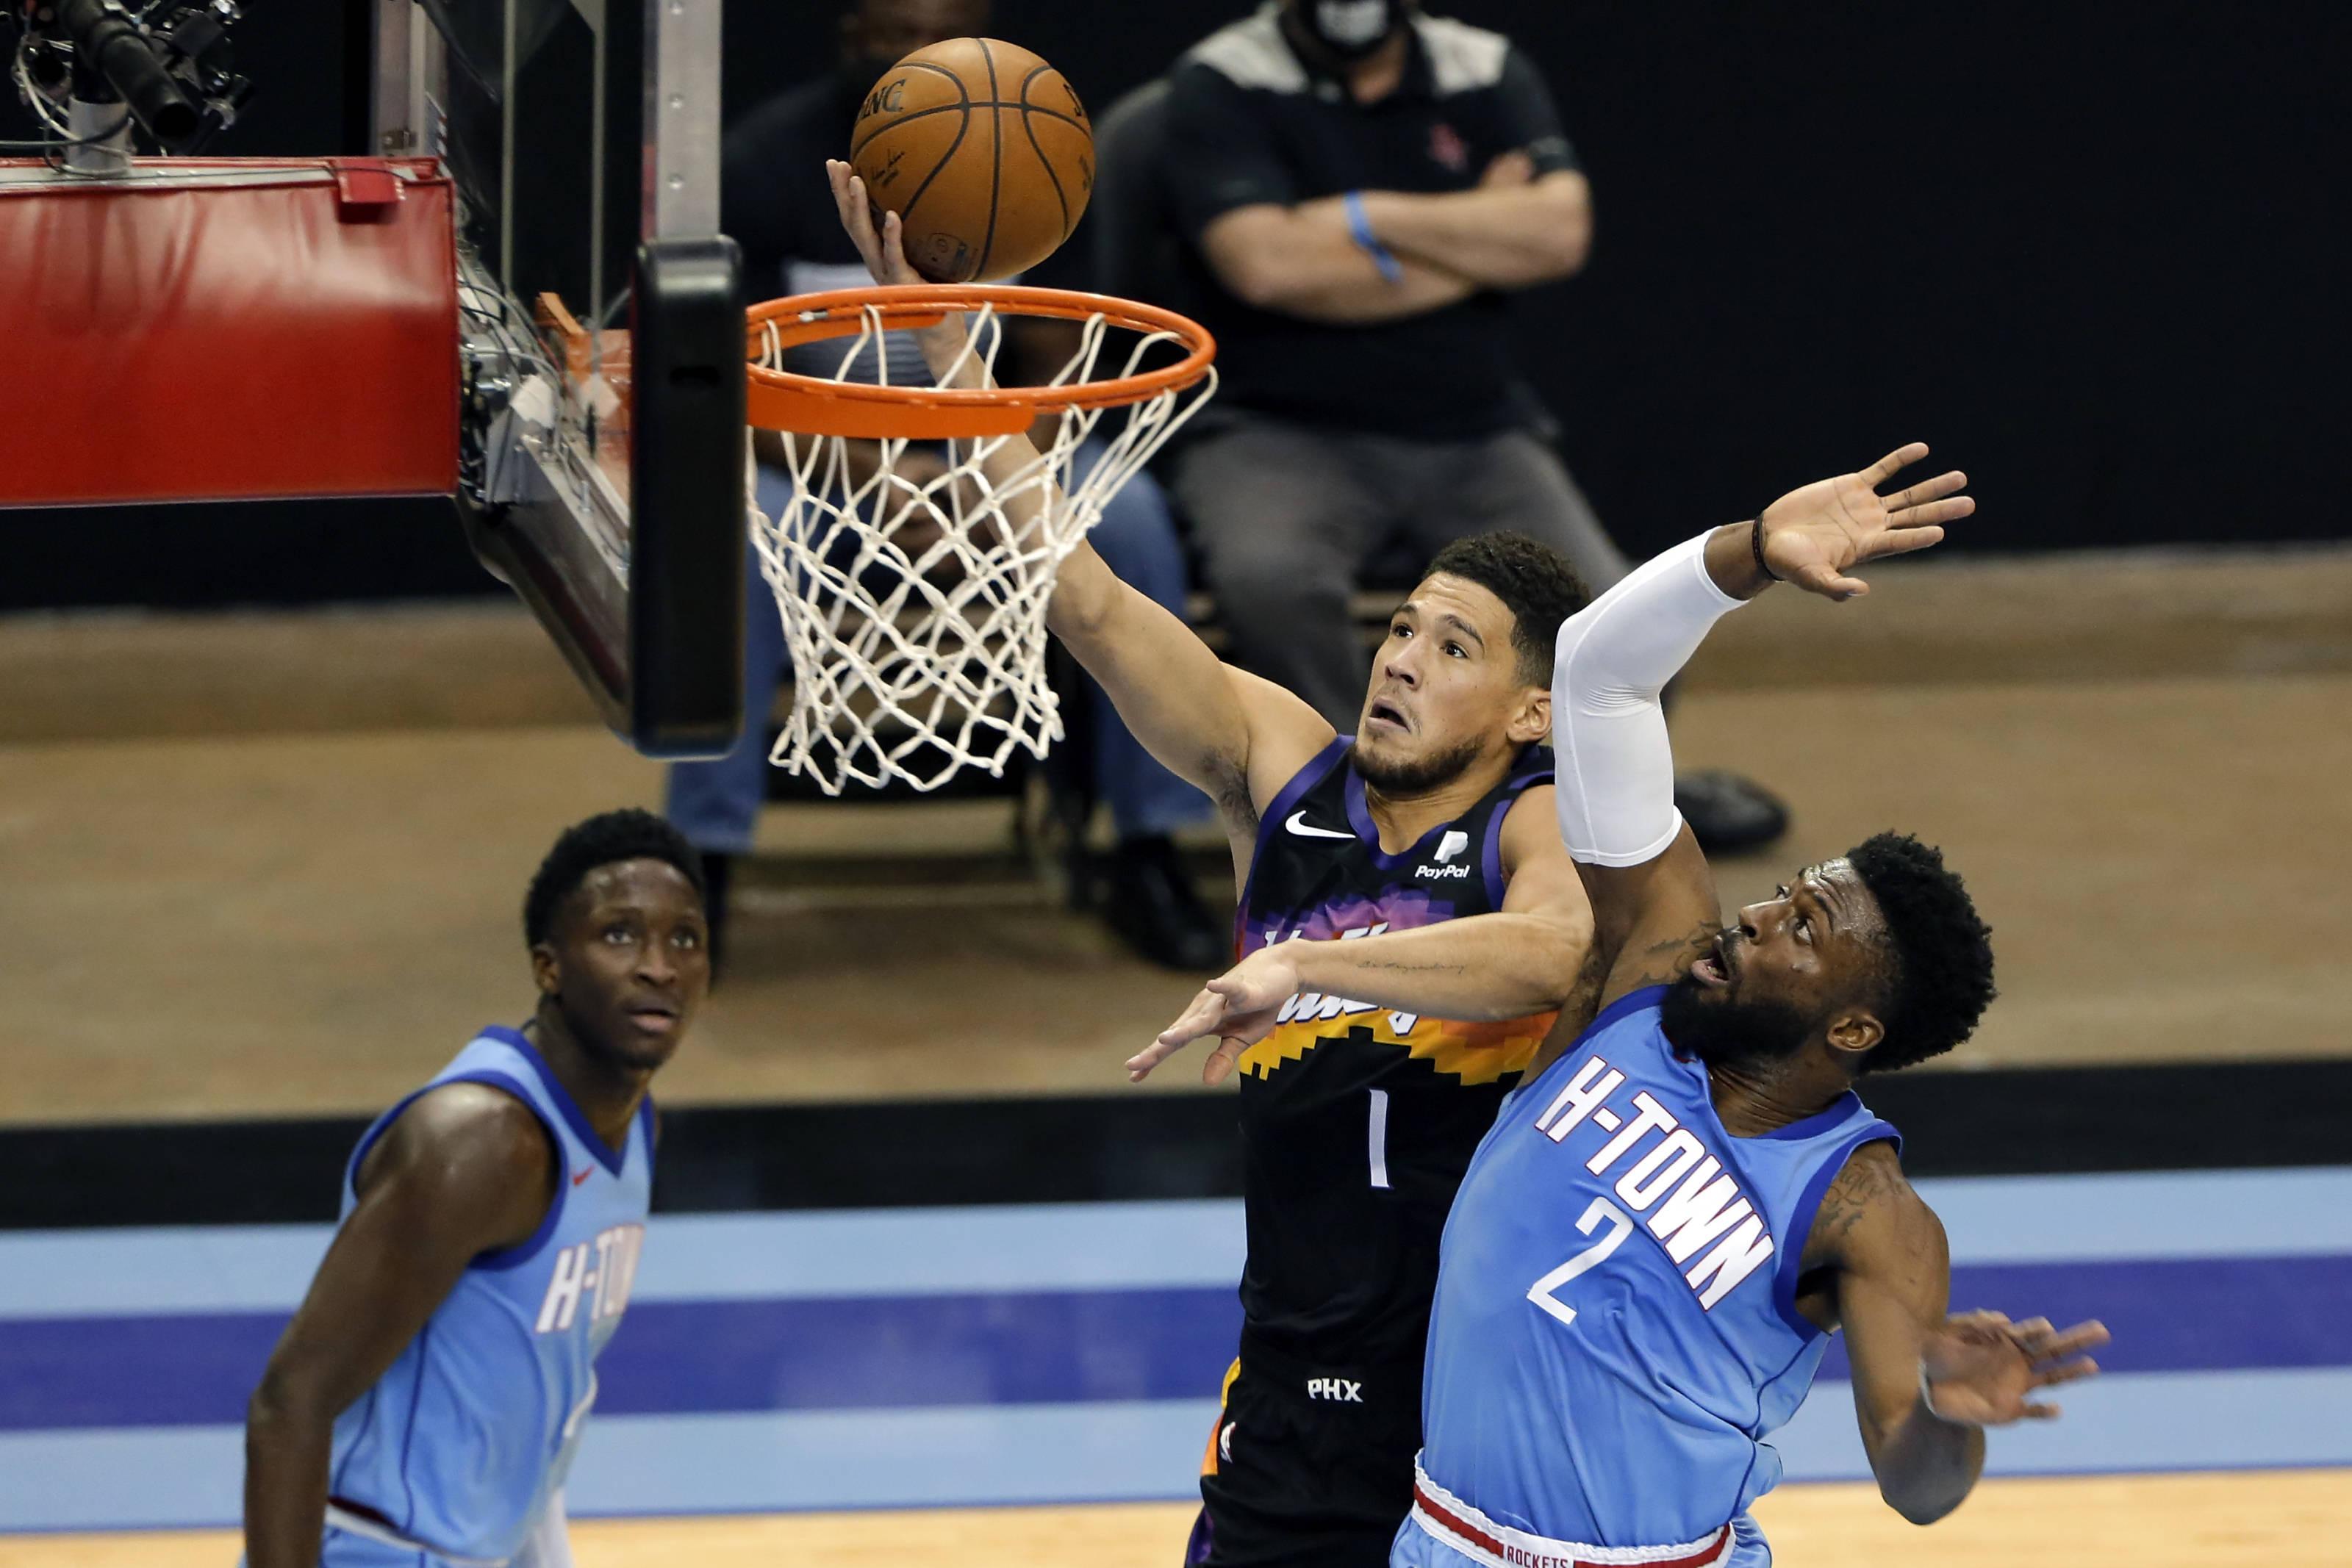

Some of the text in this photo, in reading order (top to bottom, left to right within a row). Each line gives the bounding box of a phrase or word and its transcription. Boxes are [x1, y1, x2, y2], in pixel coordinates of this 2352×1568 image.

[1414, 865, 1470, 880] PayPal
[1369, 1089, 1390, 1188] 1
[1534, 1055, 1774, 1312] H-TOWN
[1527, 1196, 1635, 1325] 2
[1308, 1377, 1363, 1403] PHX
[1507, 1545, 1568, 1568] ROCKETS
